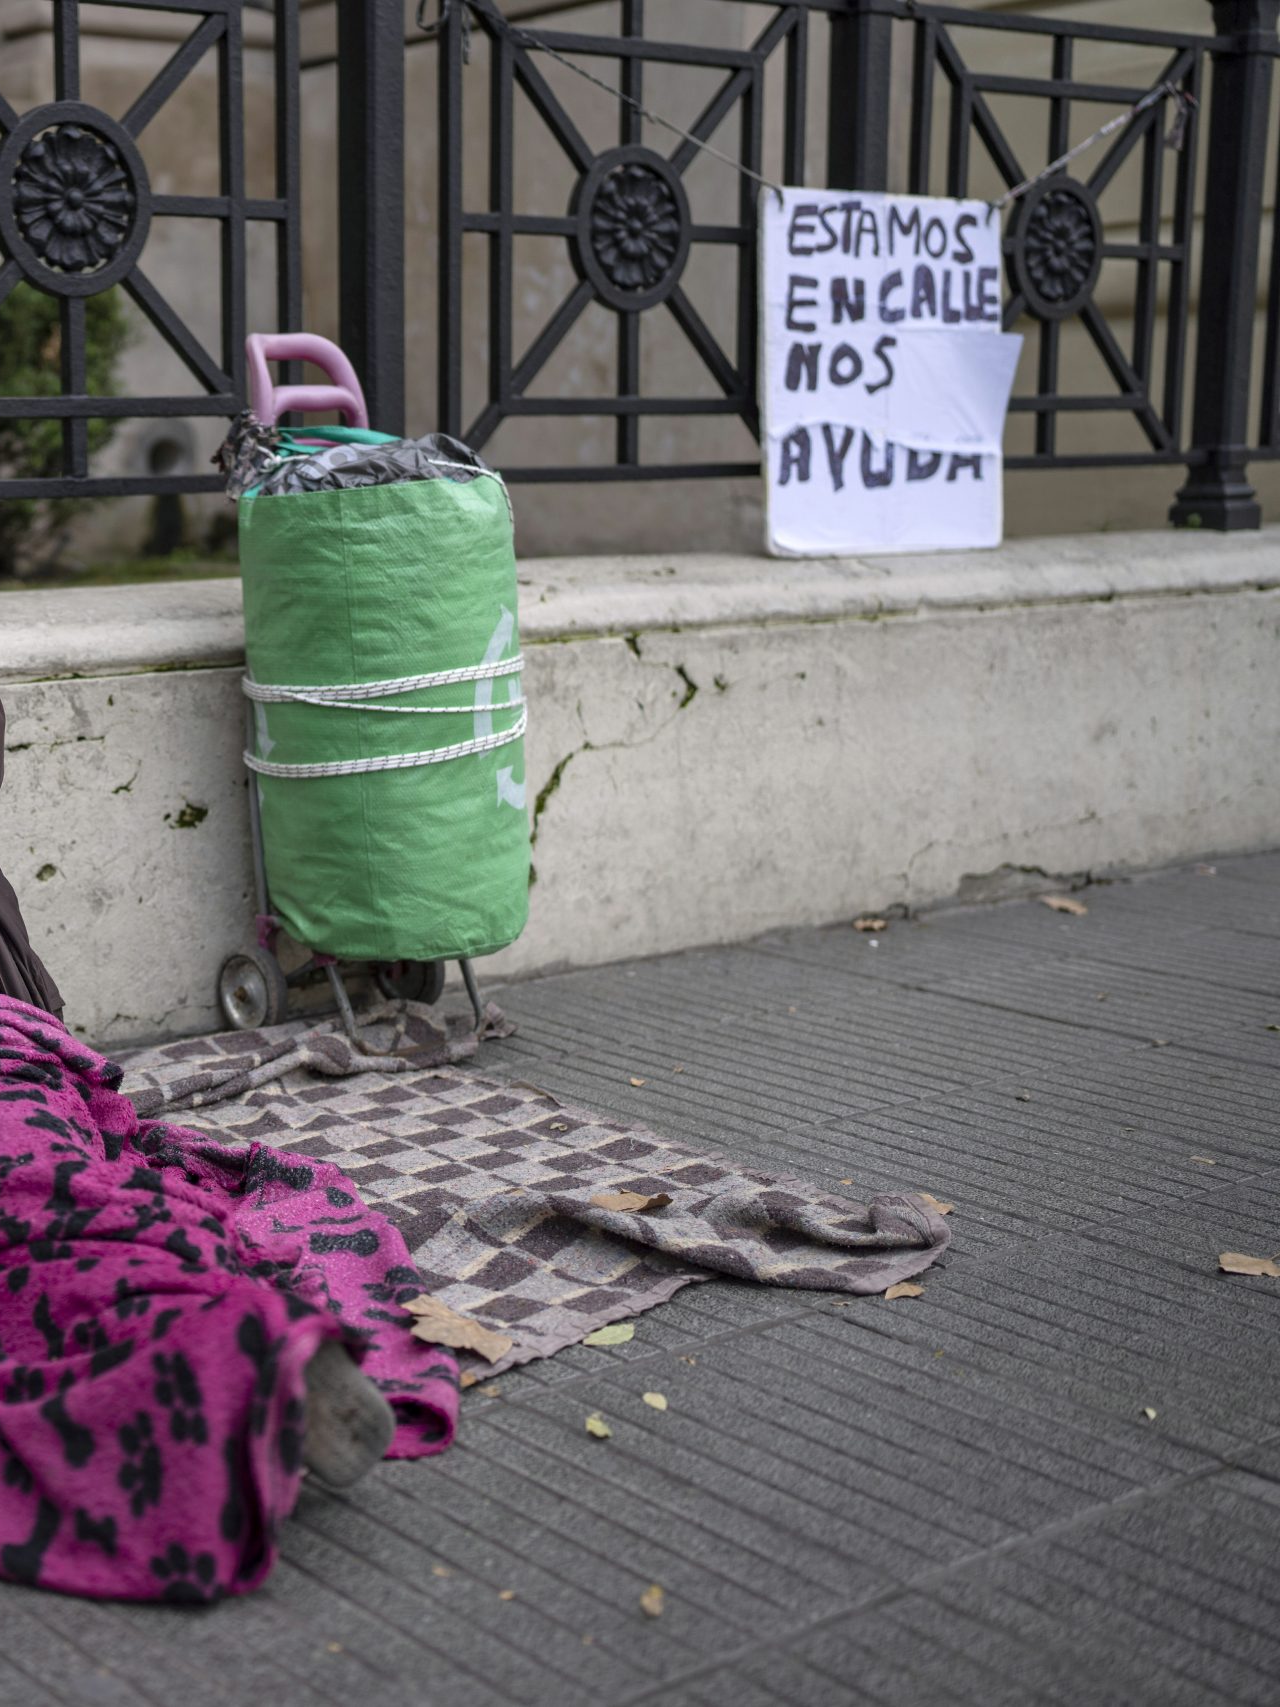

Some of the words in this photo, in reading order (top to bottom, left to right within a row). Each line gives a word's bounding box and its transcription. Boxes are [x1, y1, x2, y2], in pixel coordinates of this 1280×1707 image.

[787, 201, 977, 264] ESTAMOS
[785, 274, 865, 332] EN
[877, 263, 998, 324] CALLE
[784, 336, 897, 394] NOS
